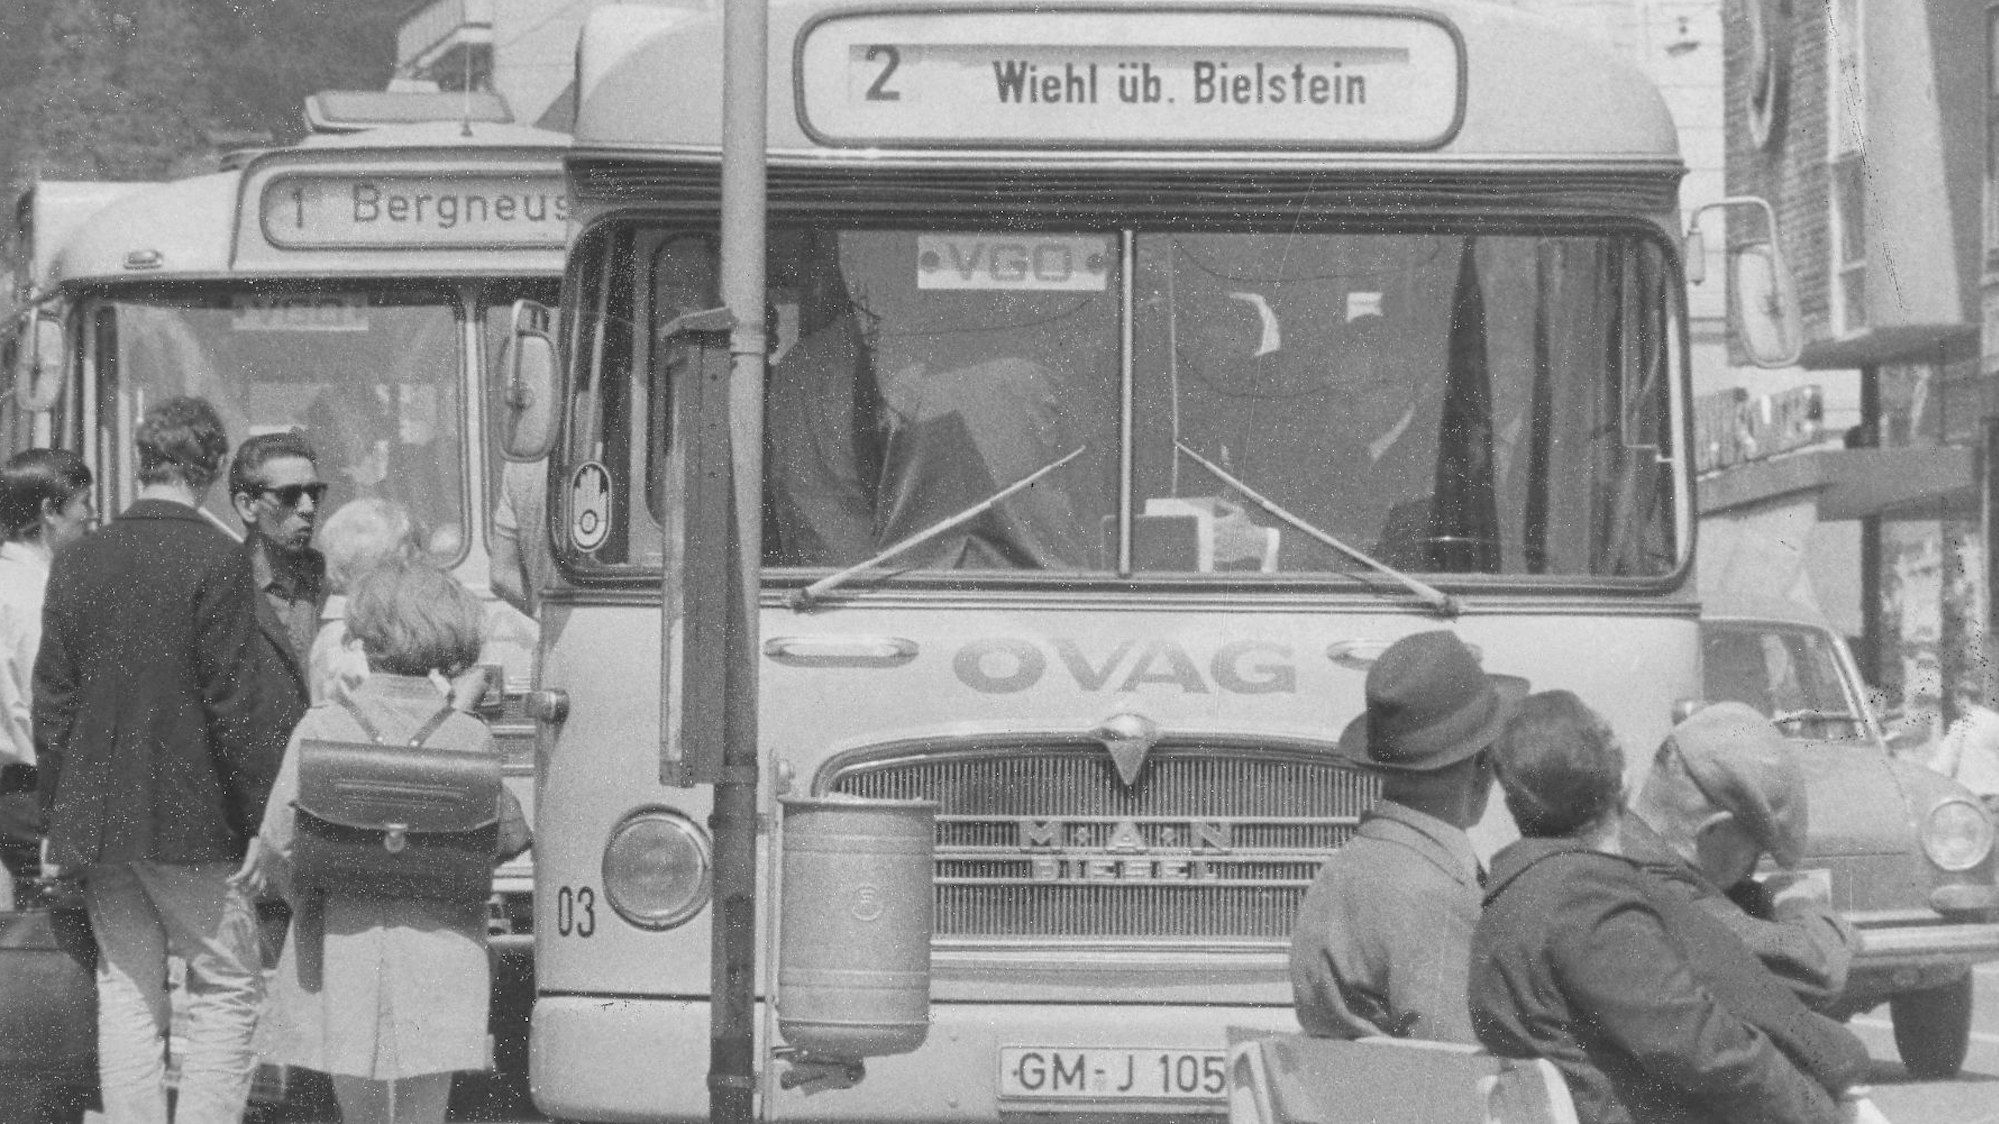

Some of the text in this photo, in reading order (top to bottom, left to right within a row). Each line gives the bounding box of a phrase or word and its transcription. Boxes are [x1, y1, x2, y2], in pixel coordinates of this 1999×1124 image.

[864, 44, 1366, 105] 2 Wiehl üb. Bielstein
[293, 184, 305, 228] 1
[952, 638, 1296, 695] OVAG
[1031, 858, 1218, 883] DIESEL
[558, 886, 596, 939] 03
[1158, 1053, 1226, 1094] 105
